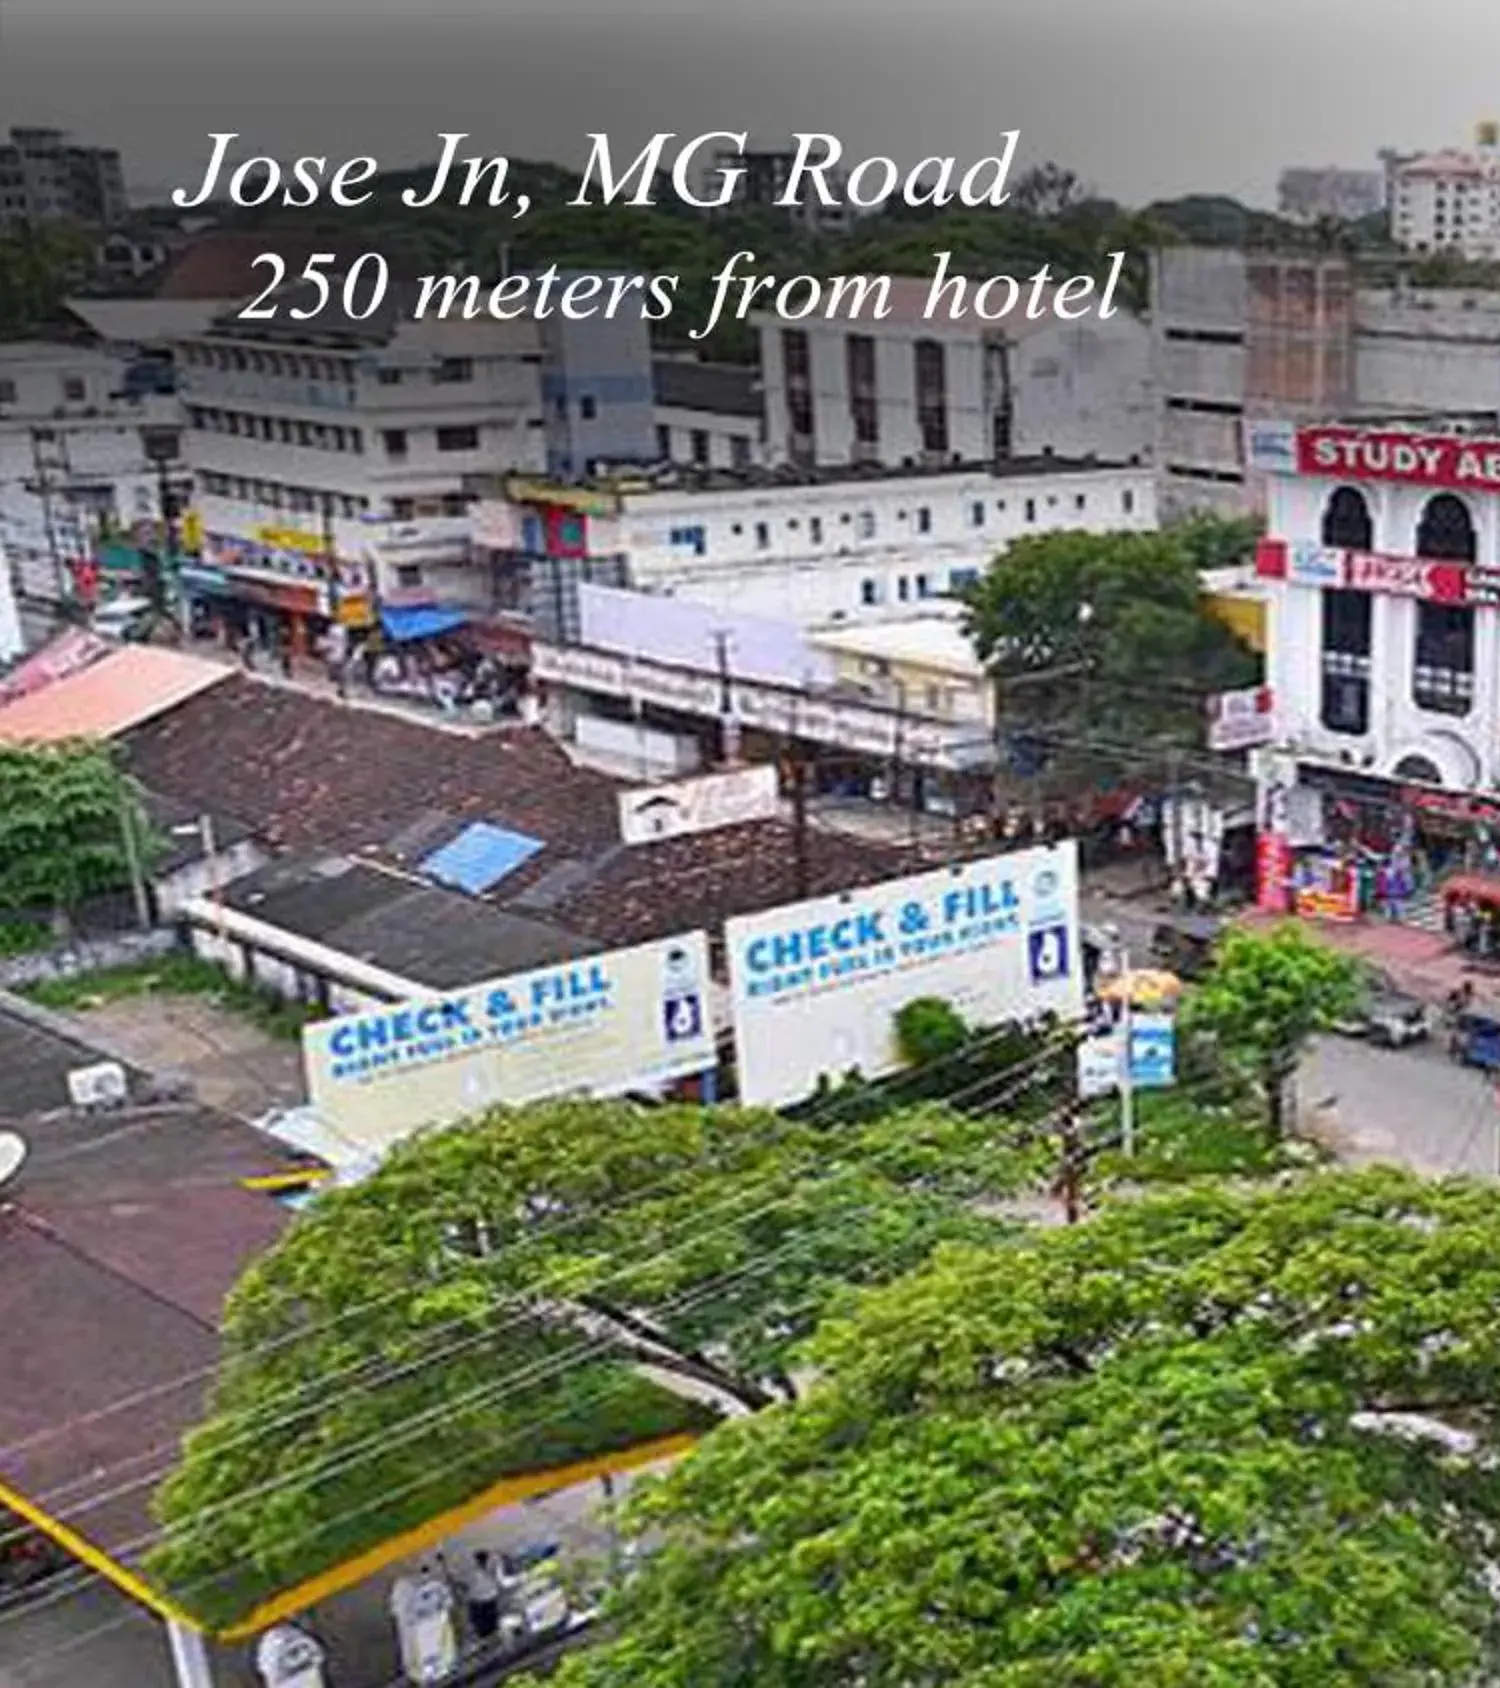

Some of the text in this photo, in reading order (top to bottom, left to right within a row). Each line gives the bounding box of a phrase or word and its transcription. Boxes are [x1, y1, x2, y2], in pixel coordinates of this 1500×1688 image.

[1314, 438, 1442, 475] STUDY
[745, 880, 1020, 973] CHECK & FILL
[328, 965, 612, 1057] CHECK & FILL
